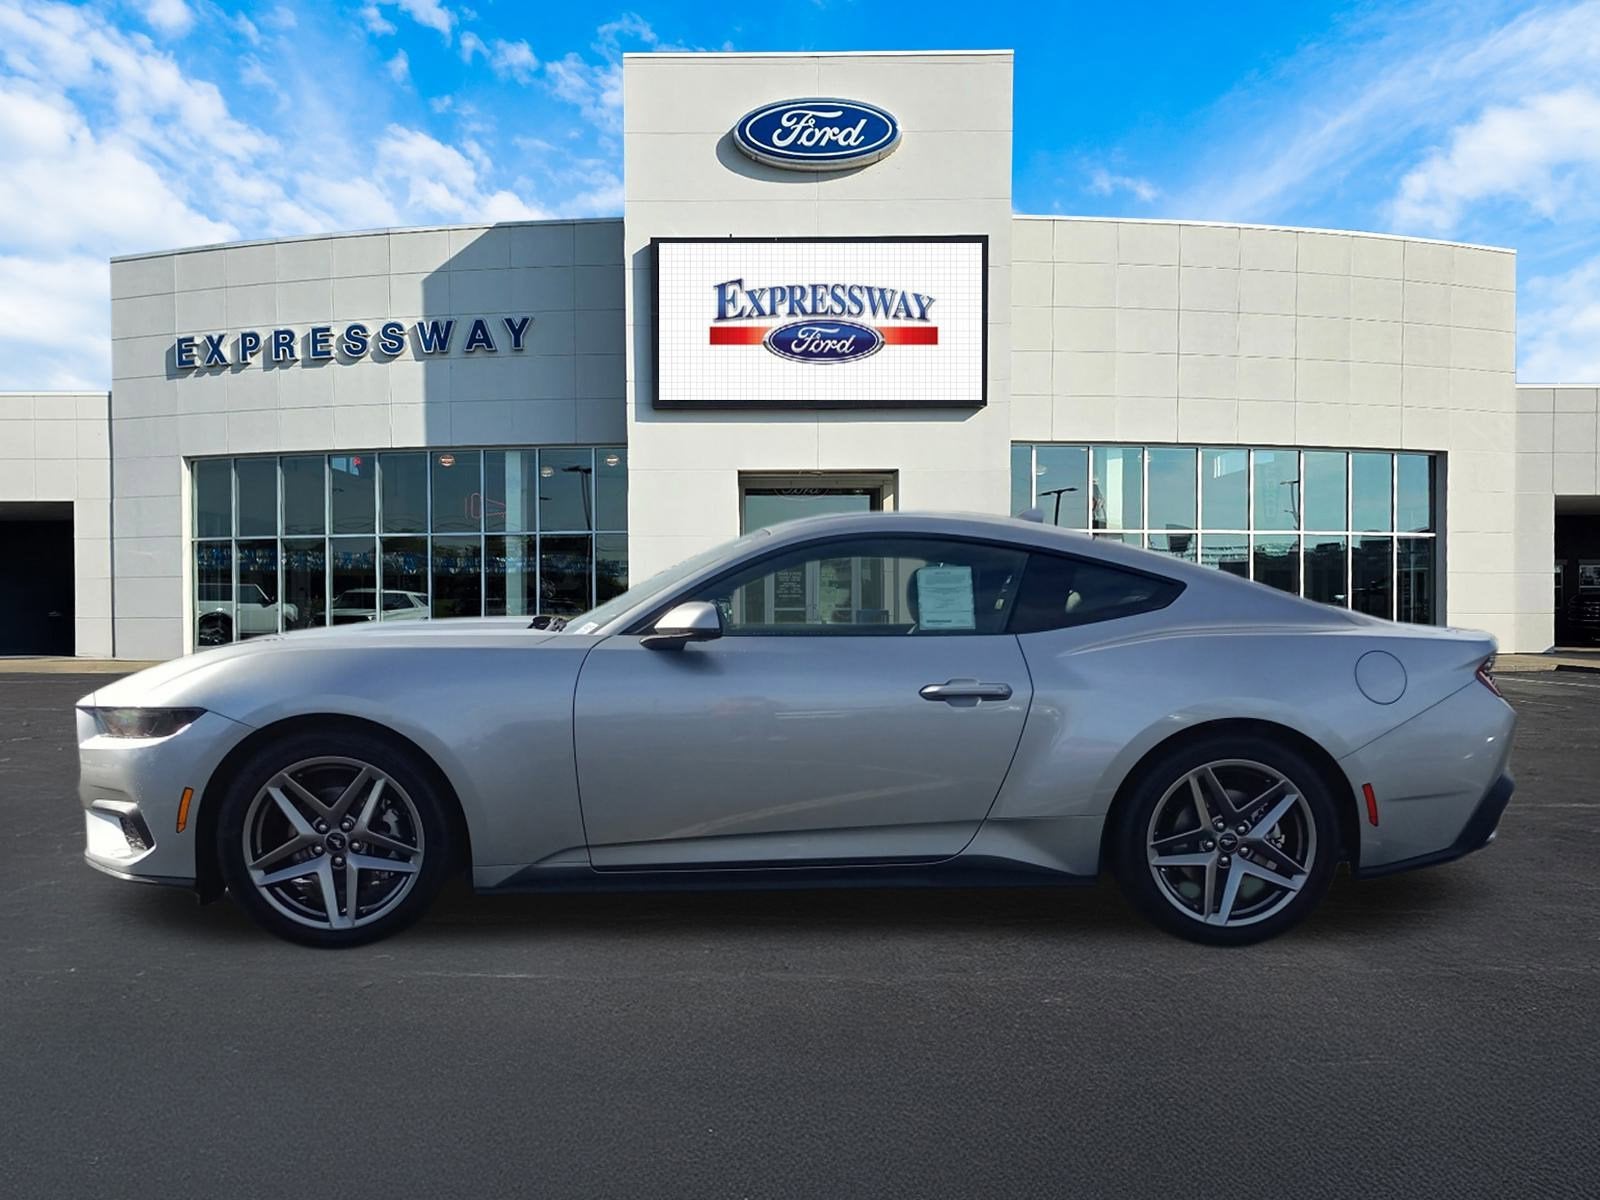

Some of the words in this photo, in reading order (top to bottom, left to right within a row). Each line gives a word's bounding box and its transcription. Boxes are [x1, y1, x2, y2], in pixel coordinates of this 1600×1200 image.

[772, 110, 867, 148] Ford
[713, 278, 936, 322] EXPRESSWAY
[175, 316, 533, 369] EXPRESSWAY
[791, 326, 856, 354] Ford
